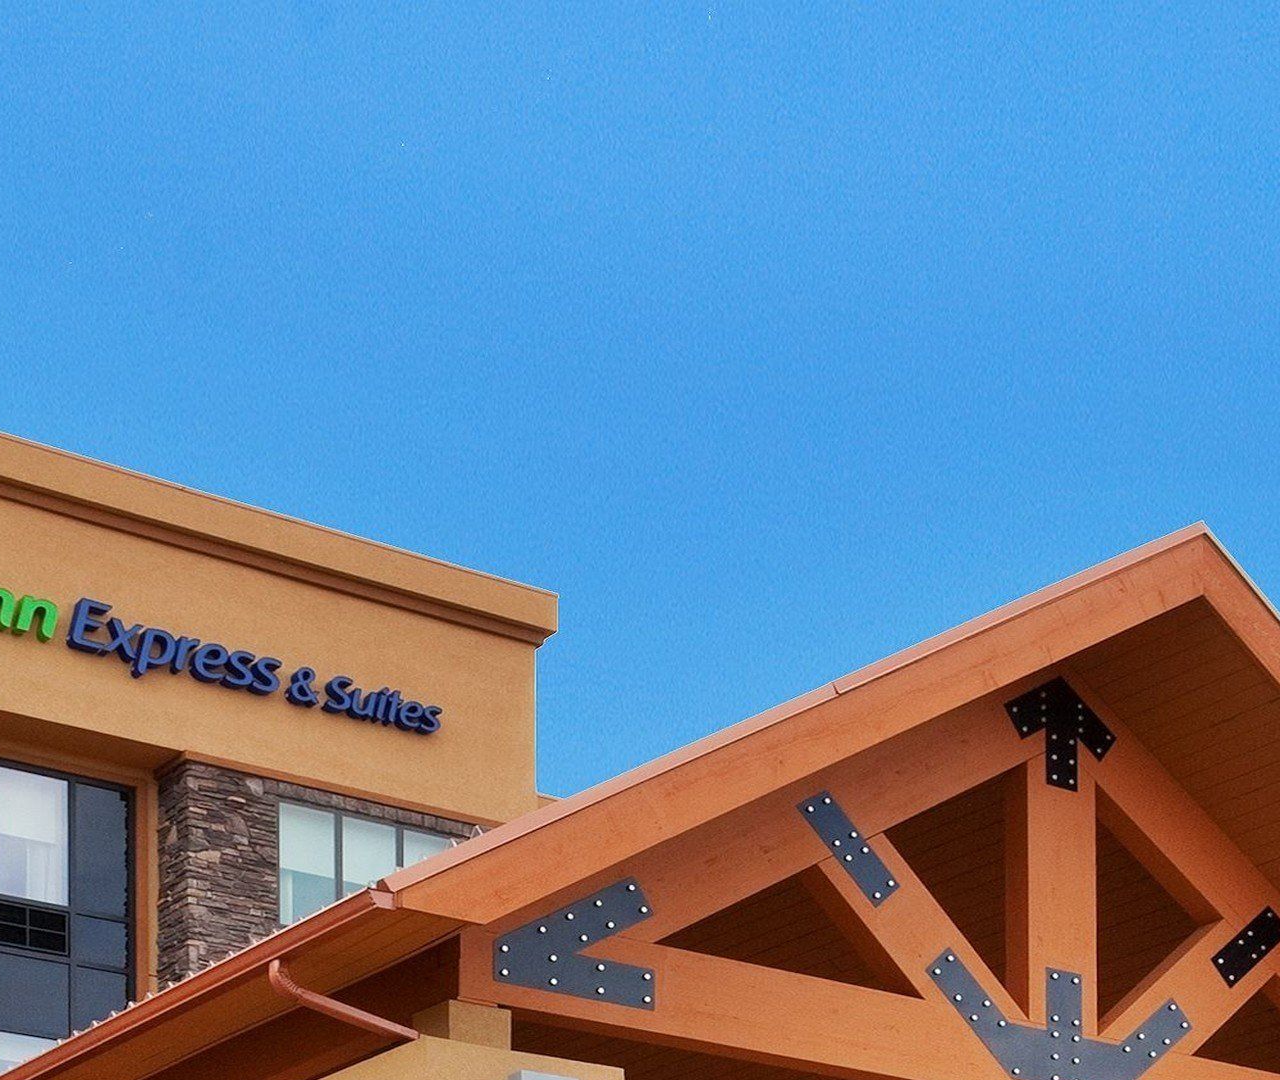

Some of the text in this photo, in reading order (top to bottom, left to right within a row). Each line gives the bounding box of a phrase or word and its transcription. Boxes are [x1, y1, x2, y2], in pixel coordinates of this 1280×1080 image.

[67, 597, 283, 697] Express
[284, 666, 319, 708] &
[320, 676, 443, 736] Suites
